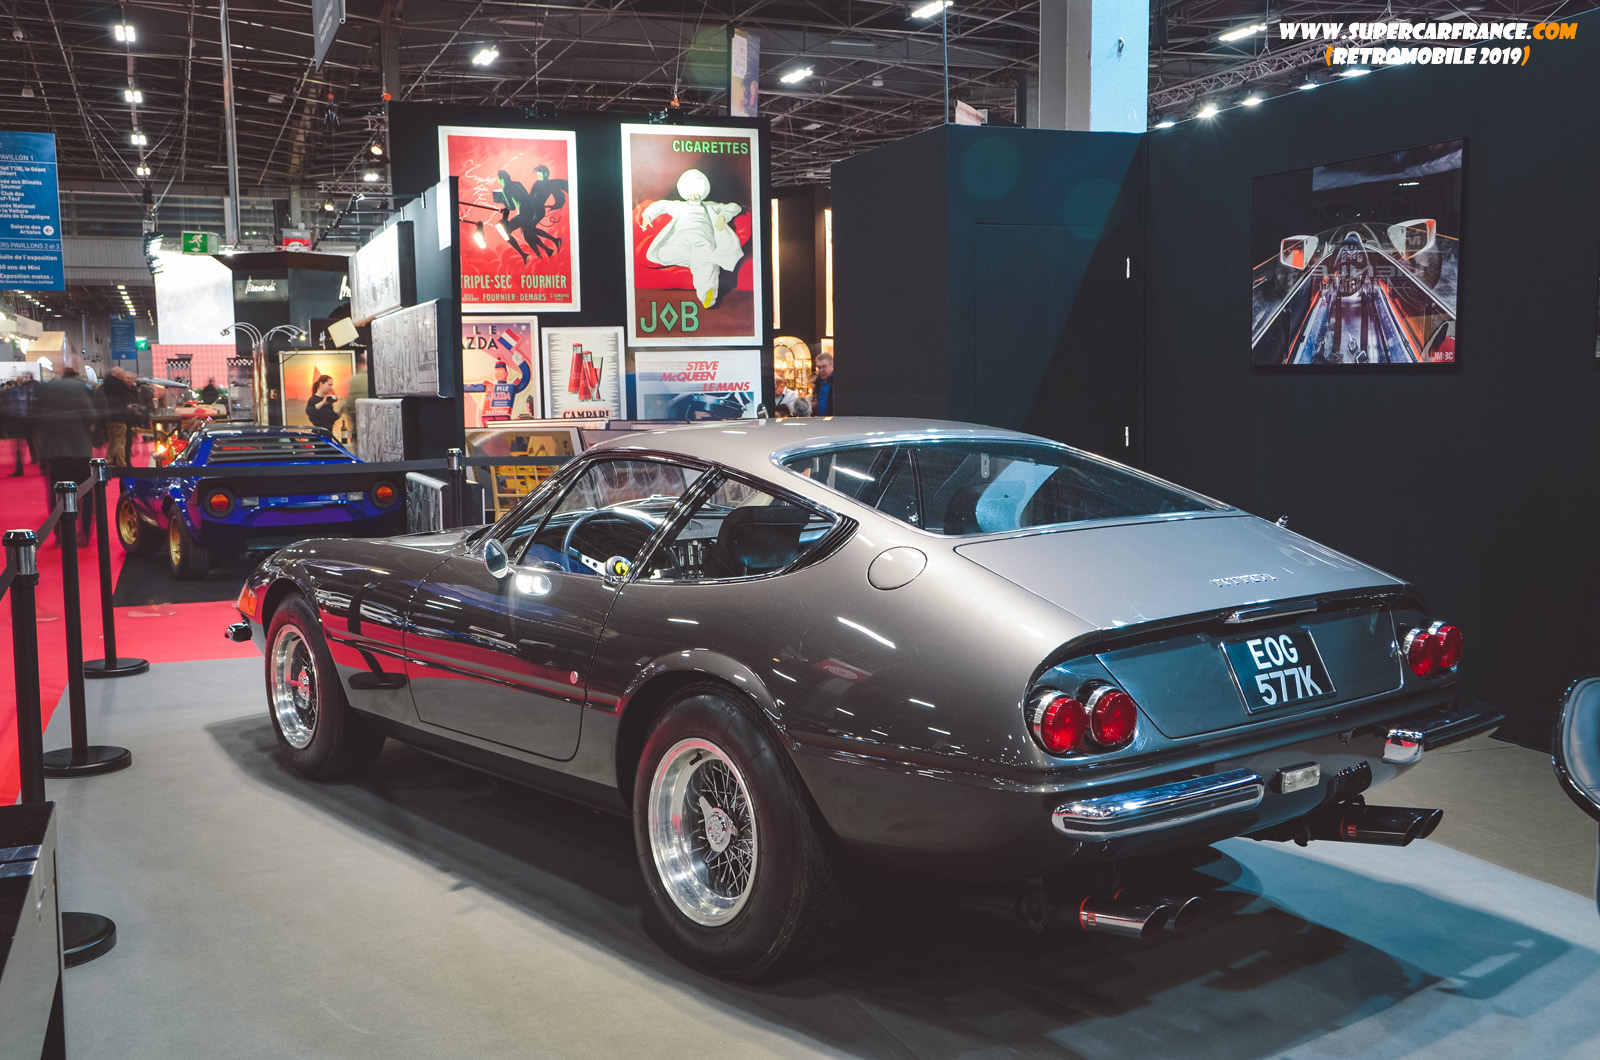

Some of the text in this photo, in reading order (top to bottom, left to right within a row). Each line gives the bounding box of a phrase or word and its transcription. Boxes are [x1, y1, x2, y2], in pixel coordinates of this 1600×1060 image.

[672, 140, 749, 154] CIGARETTES
[521, 275, 567, 289] FOURNIER
[640, 301, 700, 333] JOB
[686, 361, 719, 371] STEVE
[660, 371, 716, 382] McQUEEN
[703, 381, 750, 392] LE MANS
[486, 392, 512, 401] MAZDA
[1246, 634, 1299, 670] EOG
[1255, 665, 1323, 706] 577K
